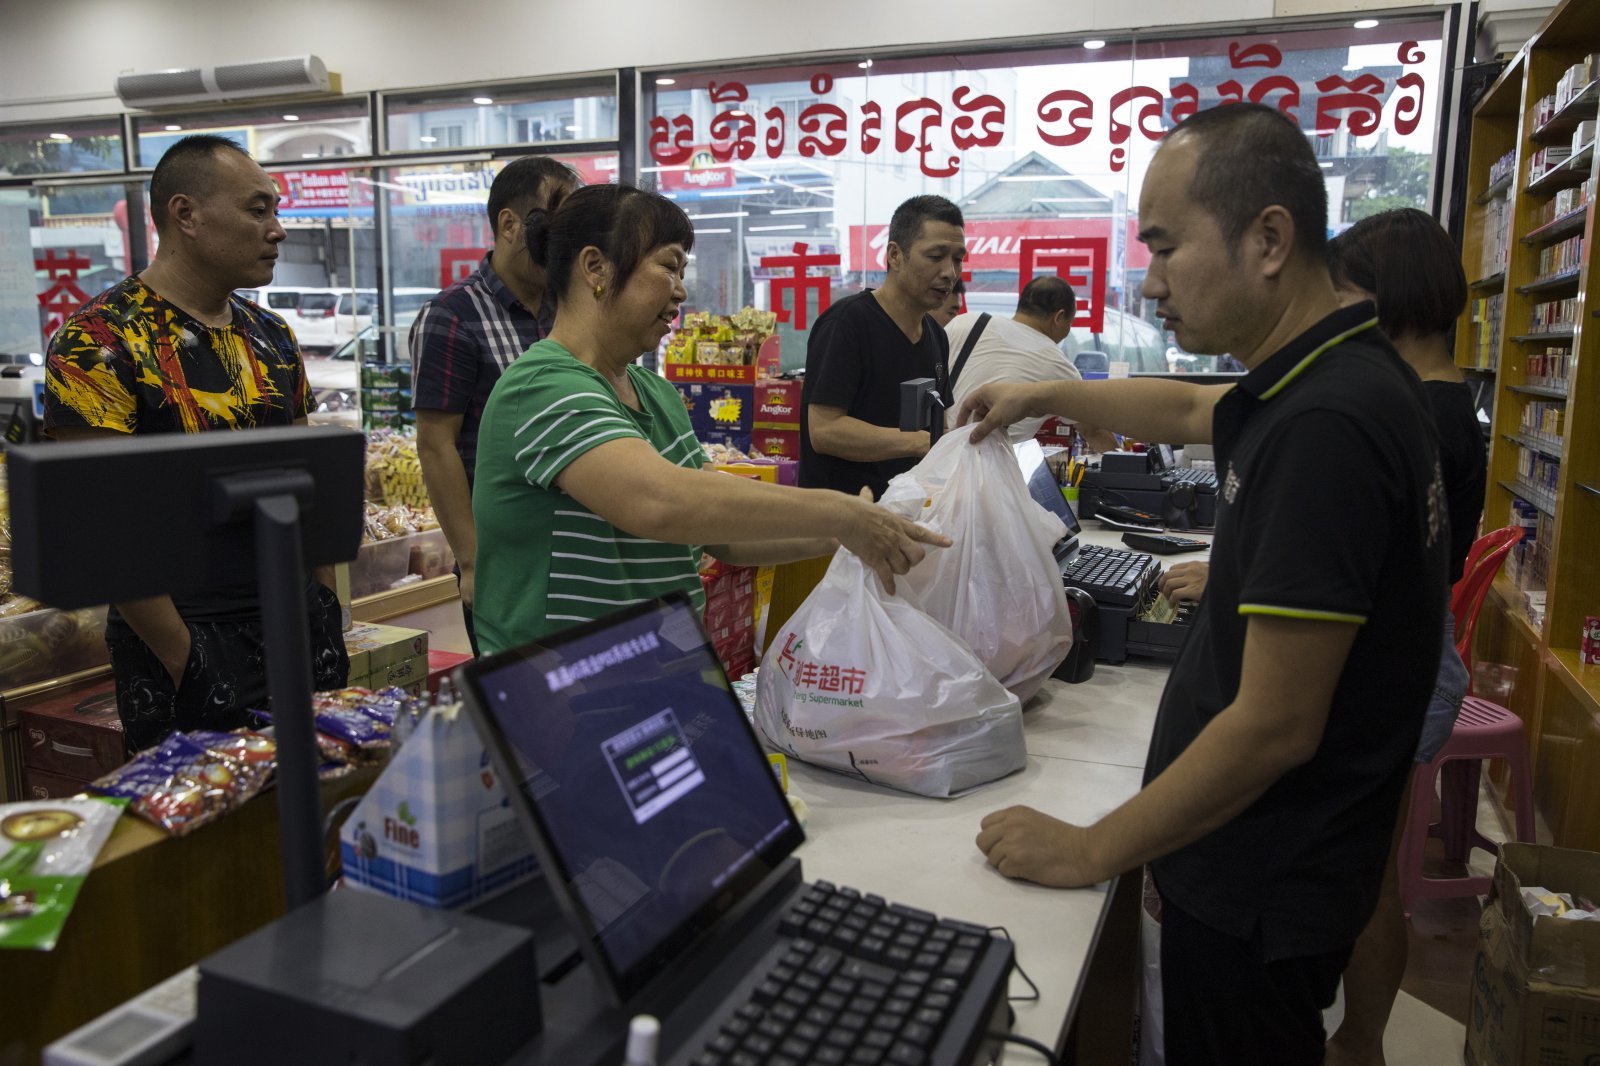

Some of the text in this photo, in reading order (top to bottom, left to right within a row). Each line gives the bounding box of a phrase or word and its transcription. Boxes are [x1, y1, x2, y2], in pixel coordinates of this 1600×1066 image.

[684, 170, 725, 186] Angkor
[760, 404, 793, 415] Angkor
[809, 692, 864, 708] Supermarket
[384, 816, 420, 850] Fine
